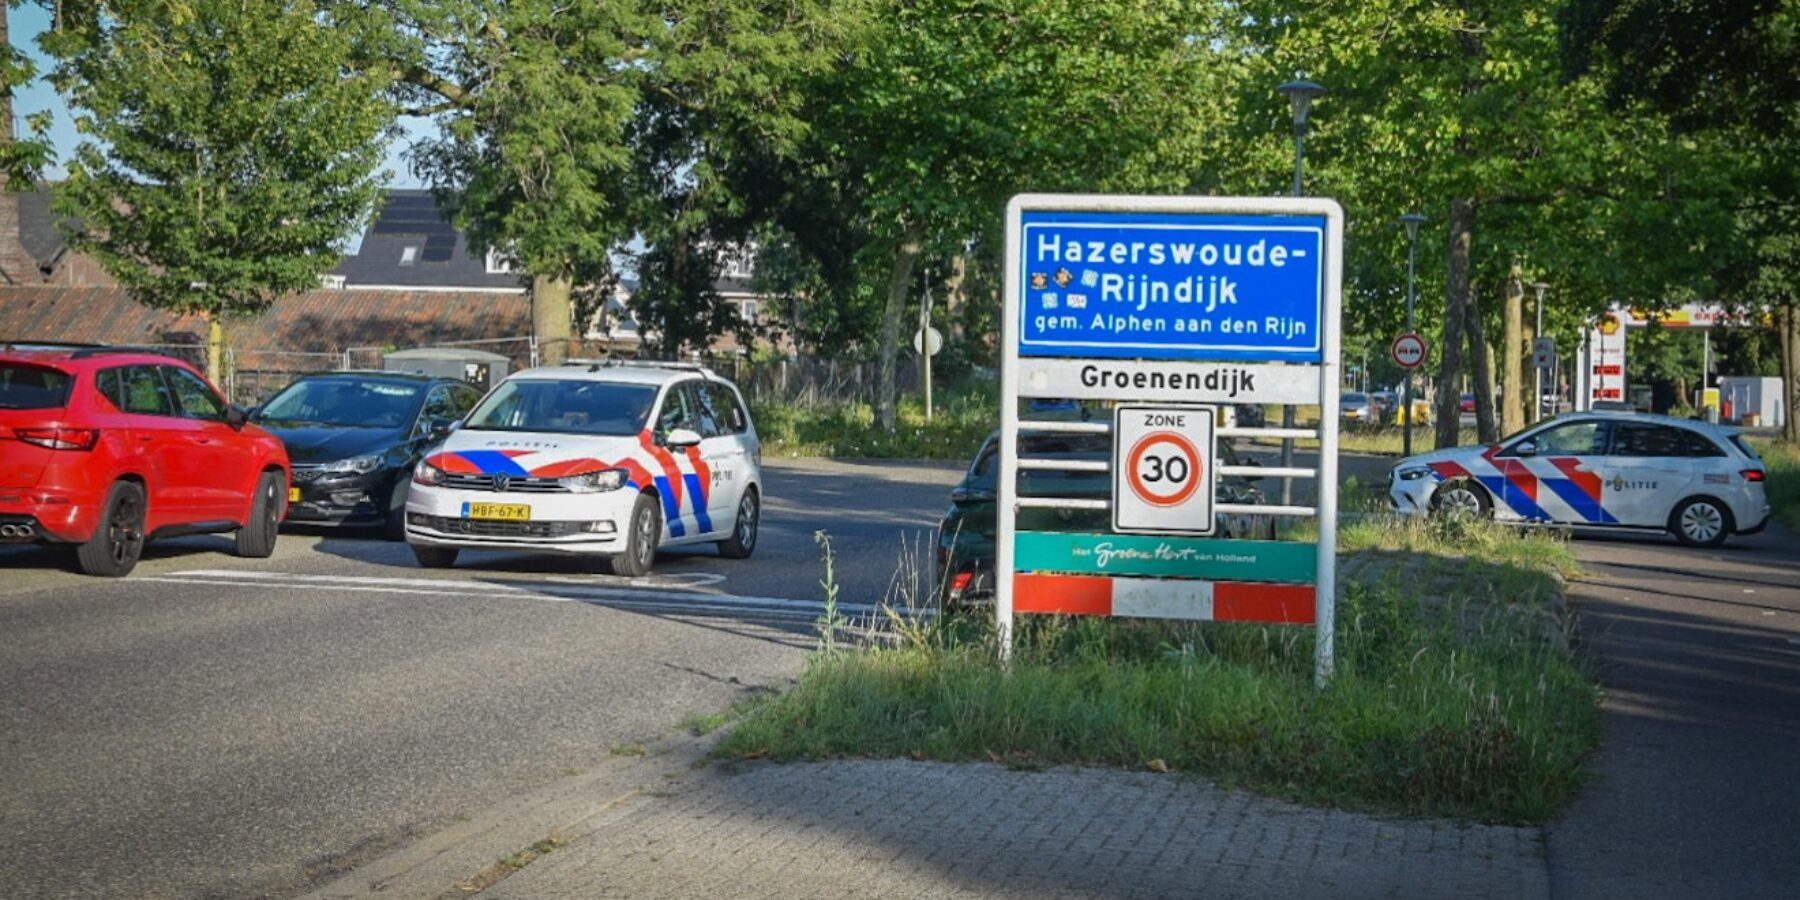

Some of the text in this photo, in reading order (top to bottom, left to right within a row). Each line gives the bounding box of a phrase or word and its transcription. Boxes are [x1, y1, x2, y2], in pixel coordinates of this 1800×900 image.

[1037, 233, 1307, 268] Hazerswoude-
[1100, 273, 1239, 313] Rijndijk
[1034, 313, 1307, 340] gem. Alphen aan den Rijn
[1080, 365, 1256, 398] Groenendijk
[1144, 414, 1186, 428] ZONE
[1141, 456, 1188, 484] 30
[472, 504, 525, 519] HBF-67-K
[1072, 547, 1091, 556] Het
[1194, 553, 1213, 561] van
[1215, 553, 1257, 564] Holland
